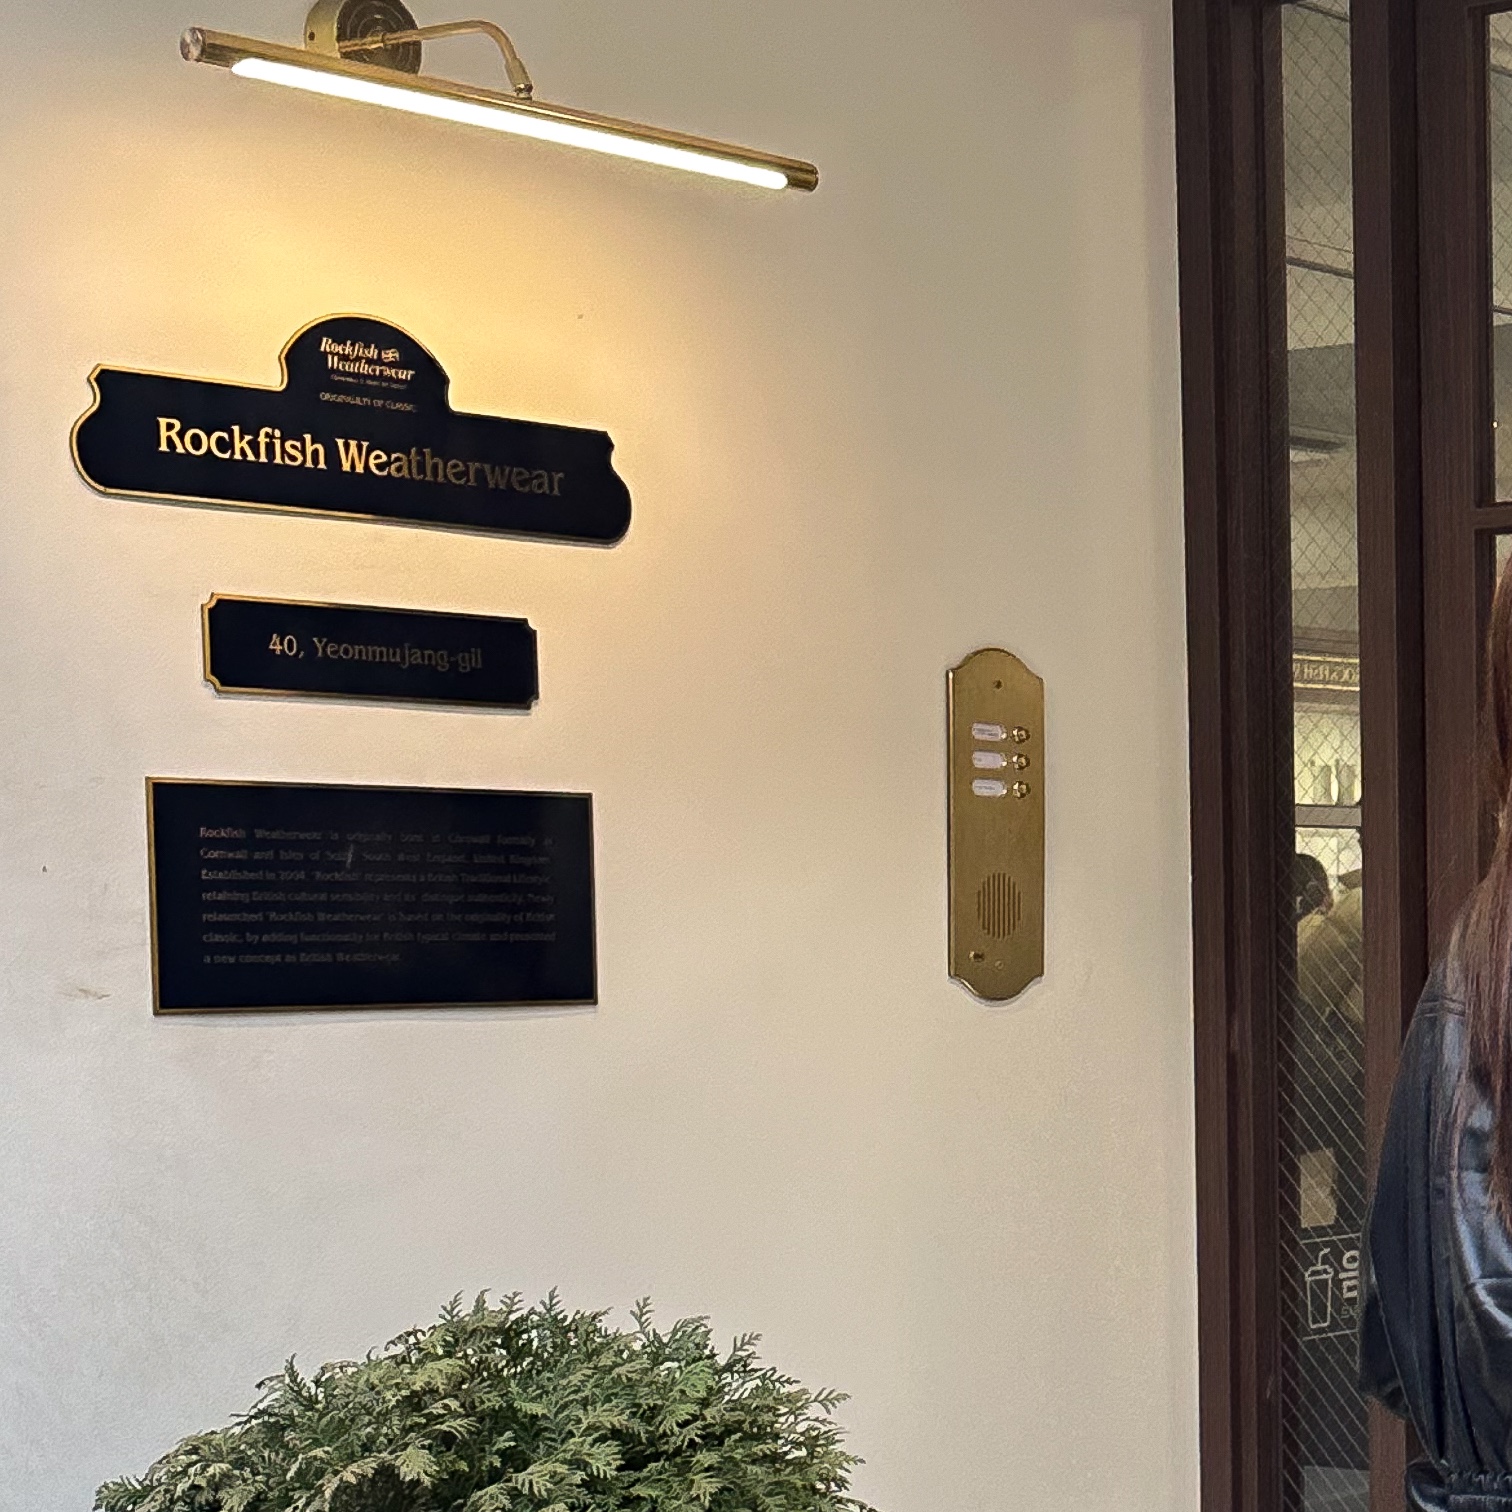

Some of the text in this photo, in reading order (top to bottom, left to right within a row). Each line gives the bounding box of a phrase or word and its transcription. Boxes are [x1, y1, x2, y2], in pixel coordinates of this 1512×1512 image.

[320, 337, 379, 360] Rockfish
[156, 416, 566, 498] Rockfish Weatherwear
[268, 633, 304, 660] 40,
